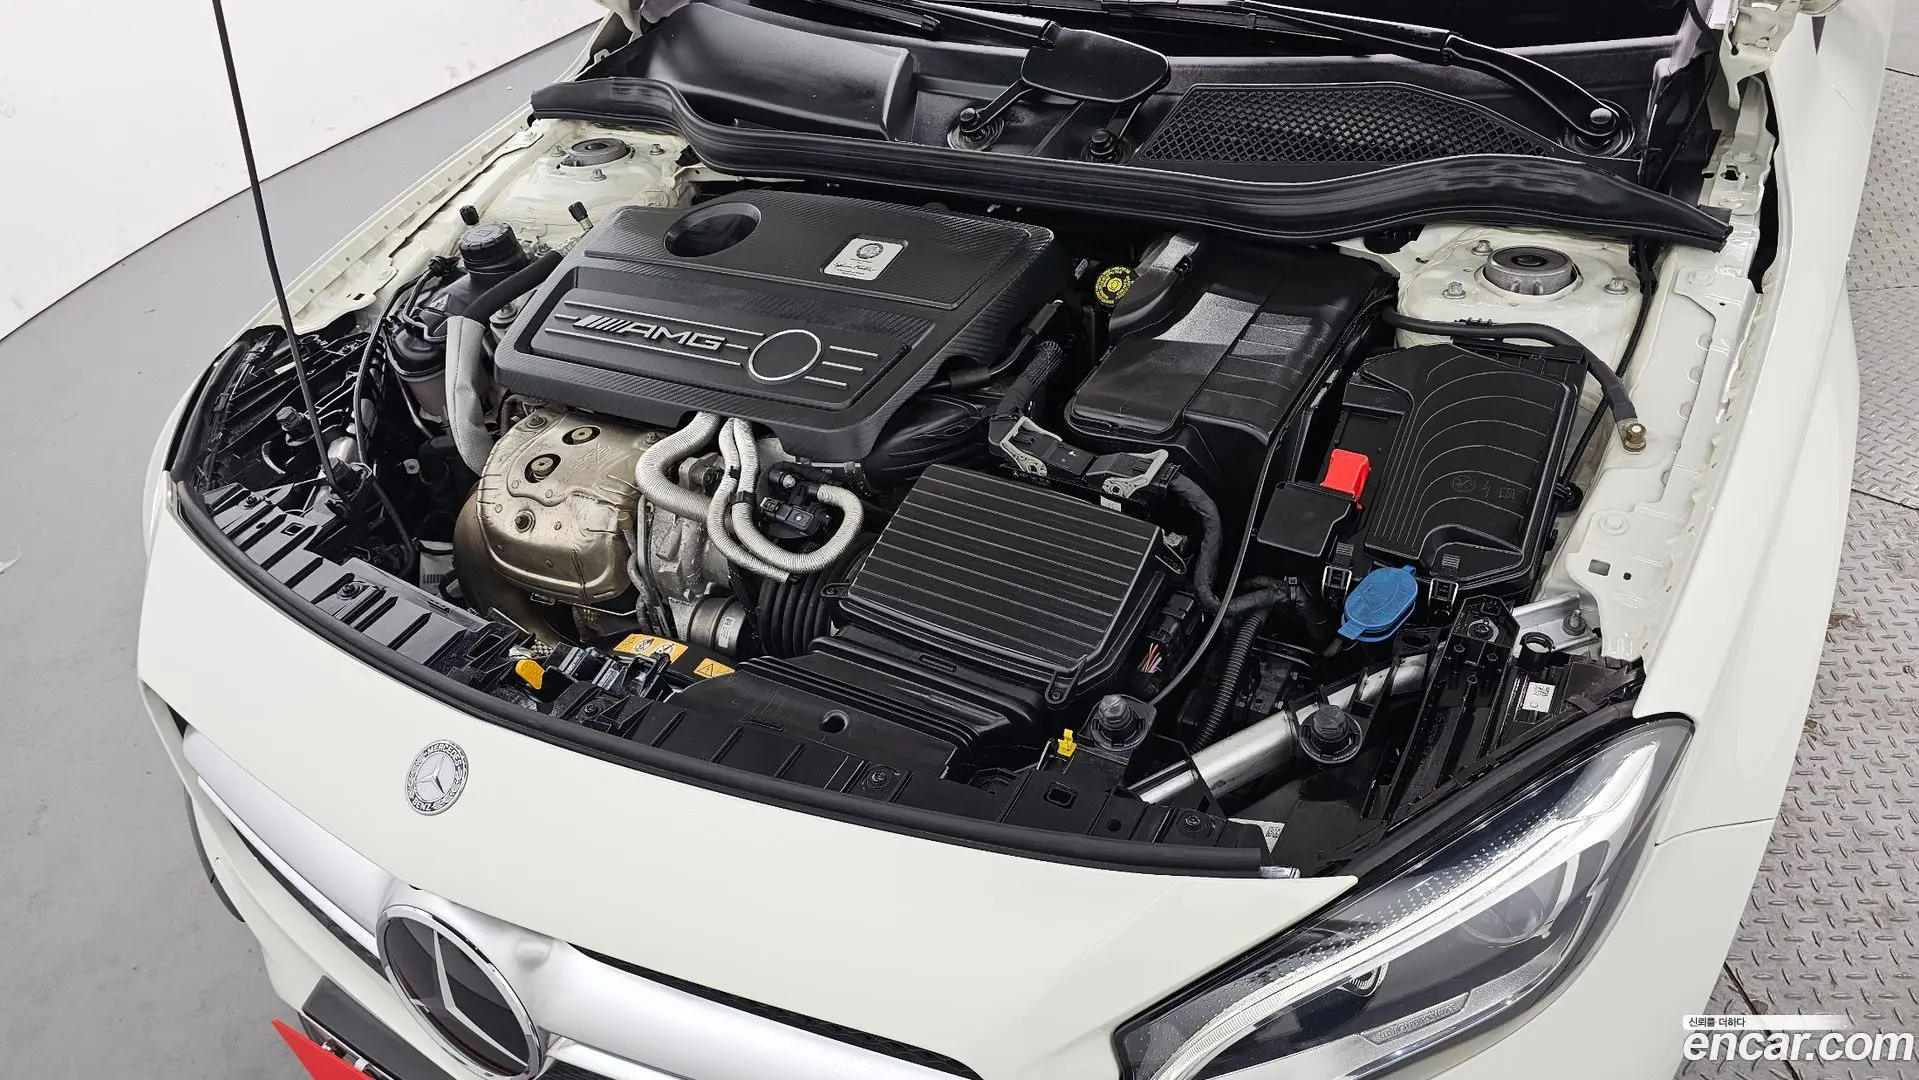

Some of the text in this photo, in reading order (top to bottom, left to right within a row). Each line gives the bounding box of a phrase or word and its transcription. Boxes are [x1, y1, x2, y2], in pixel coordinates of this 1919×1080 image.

[616, 321, 726, 350] AMG
[427, 743, 462, 767] MERCEDES
[412, 797, 432, 811] BENZ
